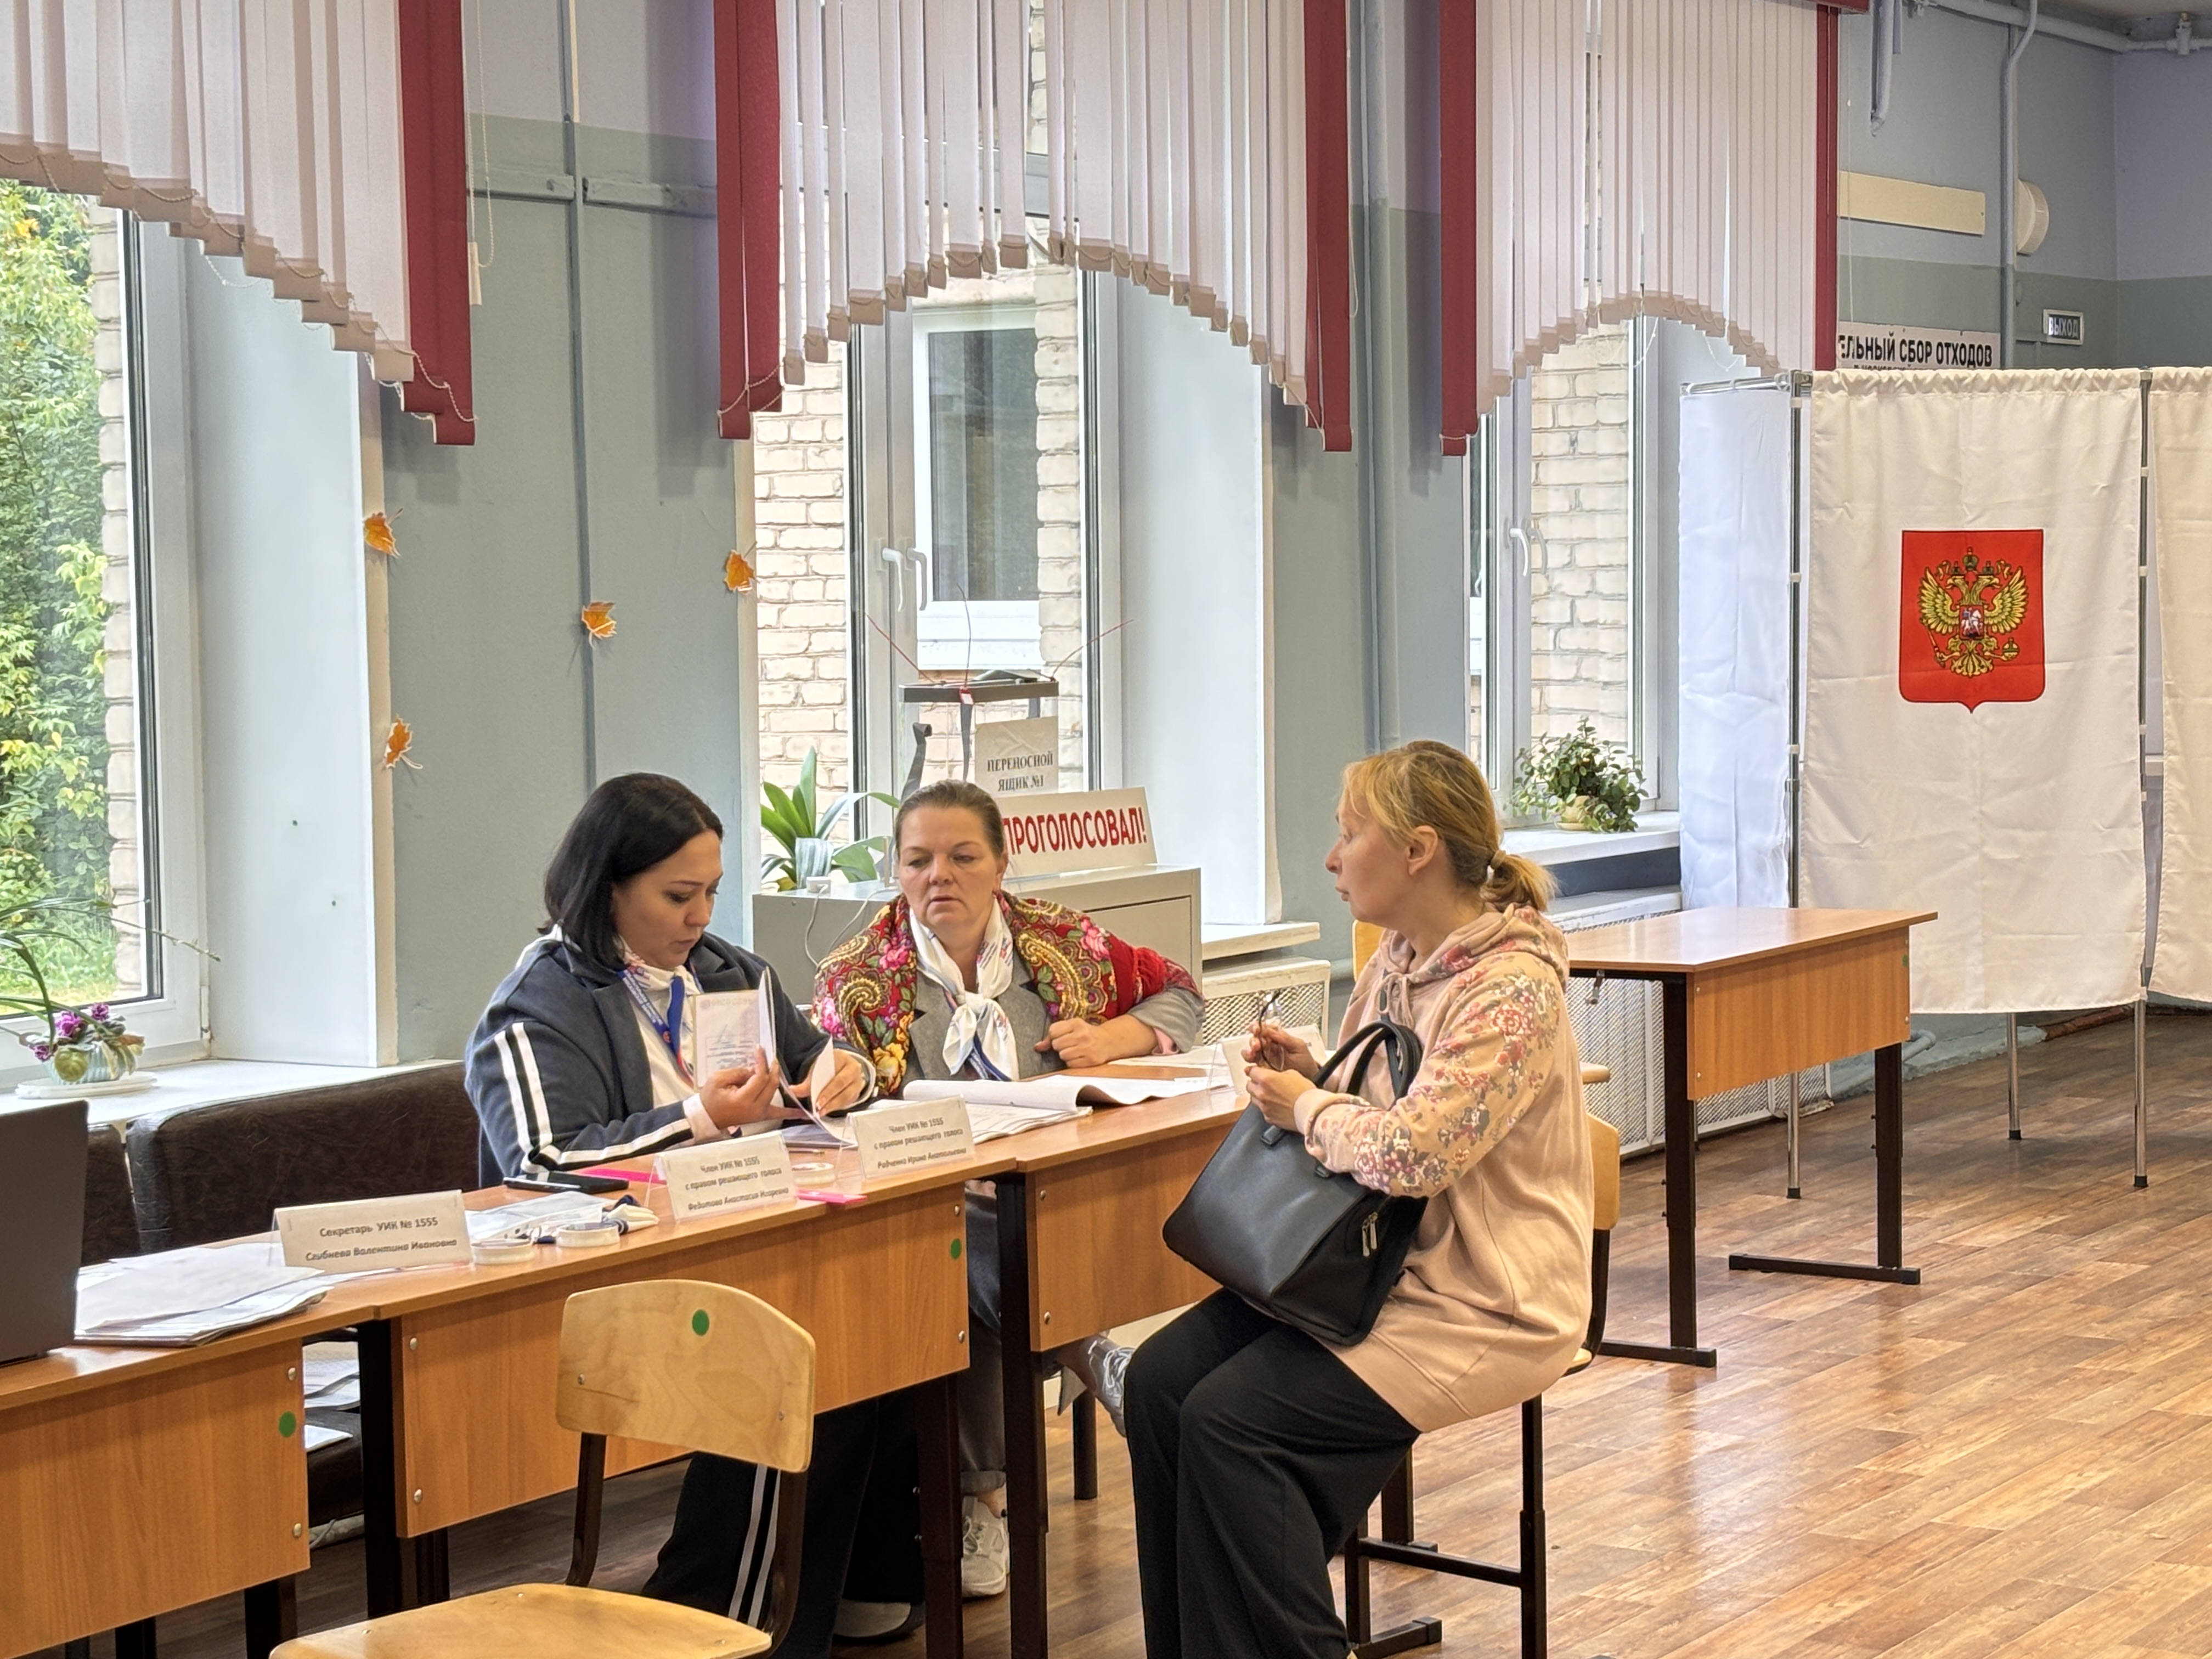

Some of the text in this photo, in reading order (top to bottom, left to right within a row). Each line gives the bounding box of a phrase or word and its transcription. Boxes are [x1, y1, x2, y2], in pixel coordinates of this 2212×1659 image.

[2049, 317, 2078, 338] ВЫХОД
[1899, 338, 1932, 363] СБОР
[1936, 341, 1993, 368] ОТХОДОВ
[988, 751, 1053, 772] ПЕРЕНОСНОЙ
[998, 777, 1029, 791] ЯЩИК
[1002, 806, 1147, 855] ПРОГОЛОСОВАЛ!
[905, 1121, 919, 1131] УИК
[879, 1139, 904, 1150] правом
[905, 1132, 941, 1146] решающего
[944, 1128, 963, 1137] голоса
[700, 1165, 718, 1173] Член
[719, 1161, 733, 1171] УИК
[690, 1179, 717, 1190] правом
[719, 1172, 758, 1186] решающего
[760, 1168, 782, 1177] голоса
[724, 1192, 758, 1204] Анастасия
[760, 1187, 789, 1198] Игоревна
[319, 1217, 438, 1238] Секретарь УИК № 1555
[353, 1243, 409, 1255] Валентина
[411, 1238, 457, 1250] Ивановна
